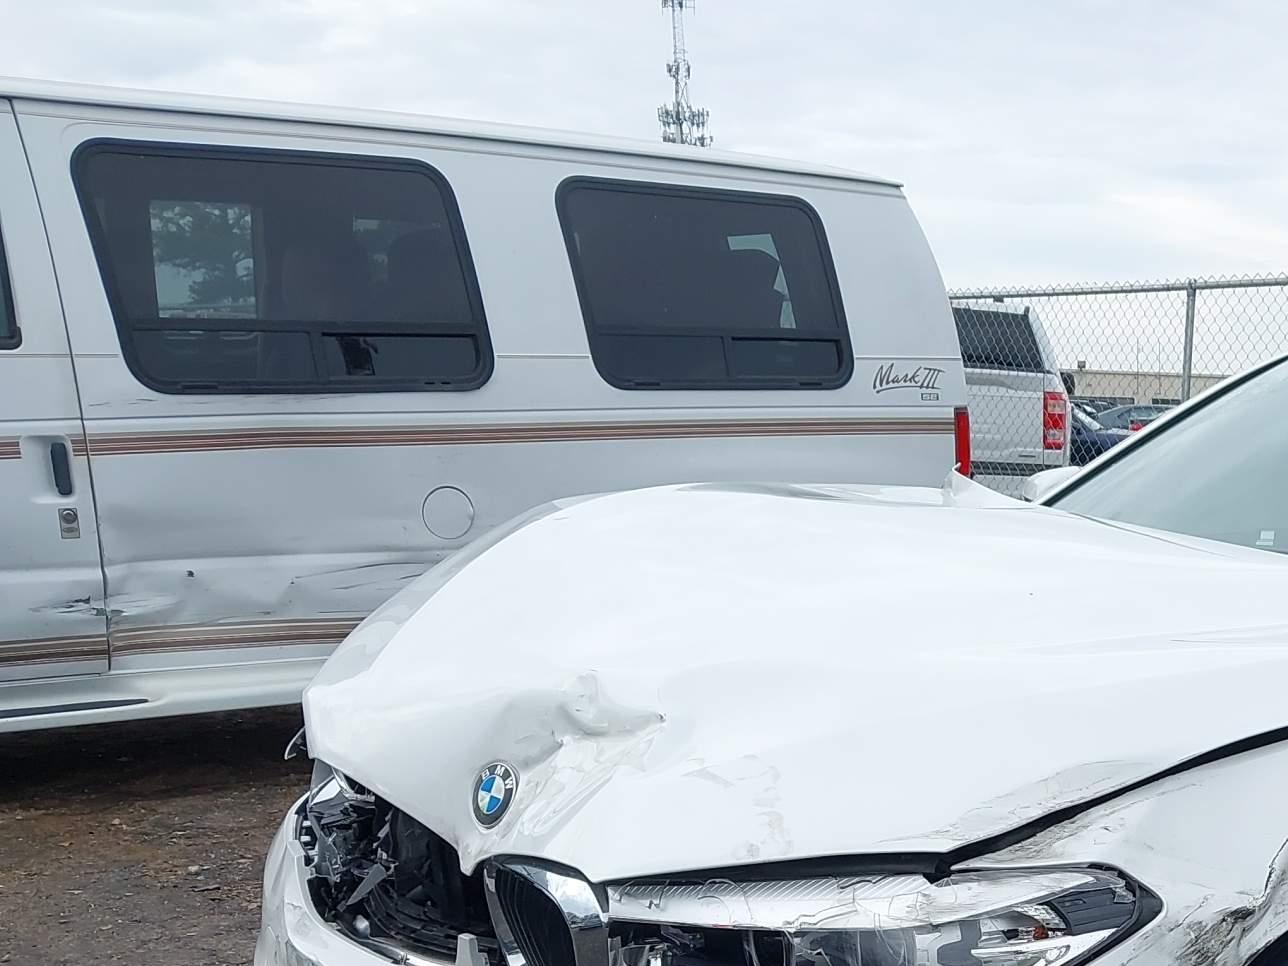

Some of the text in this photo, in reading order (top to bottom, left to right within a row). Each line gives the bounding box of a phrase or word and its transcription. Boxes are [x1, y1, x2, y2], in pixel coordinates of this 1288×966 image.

[872, 362, 945, 390] Mark III
[481, 764, 514, 789] BMW
